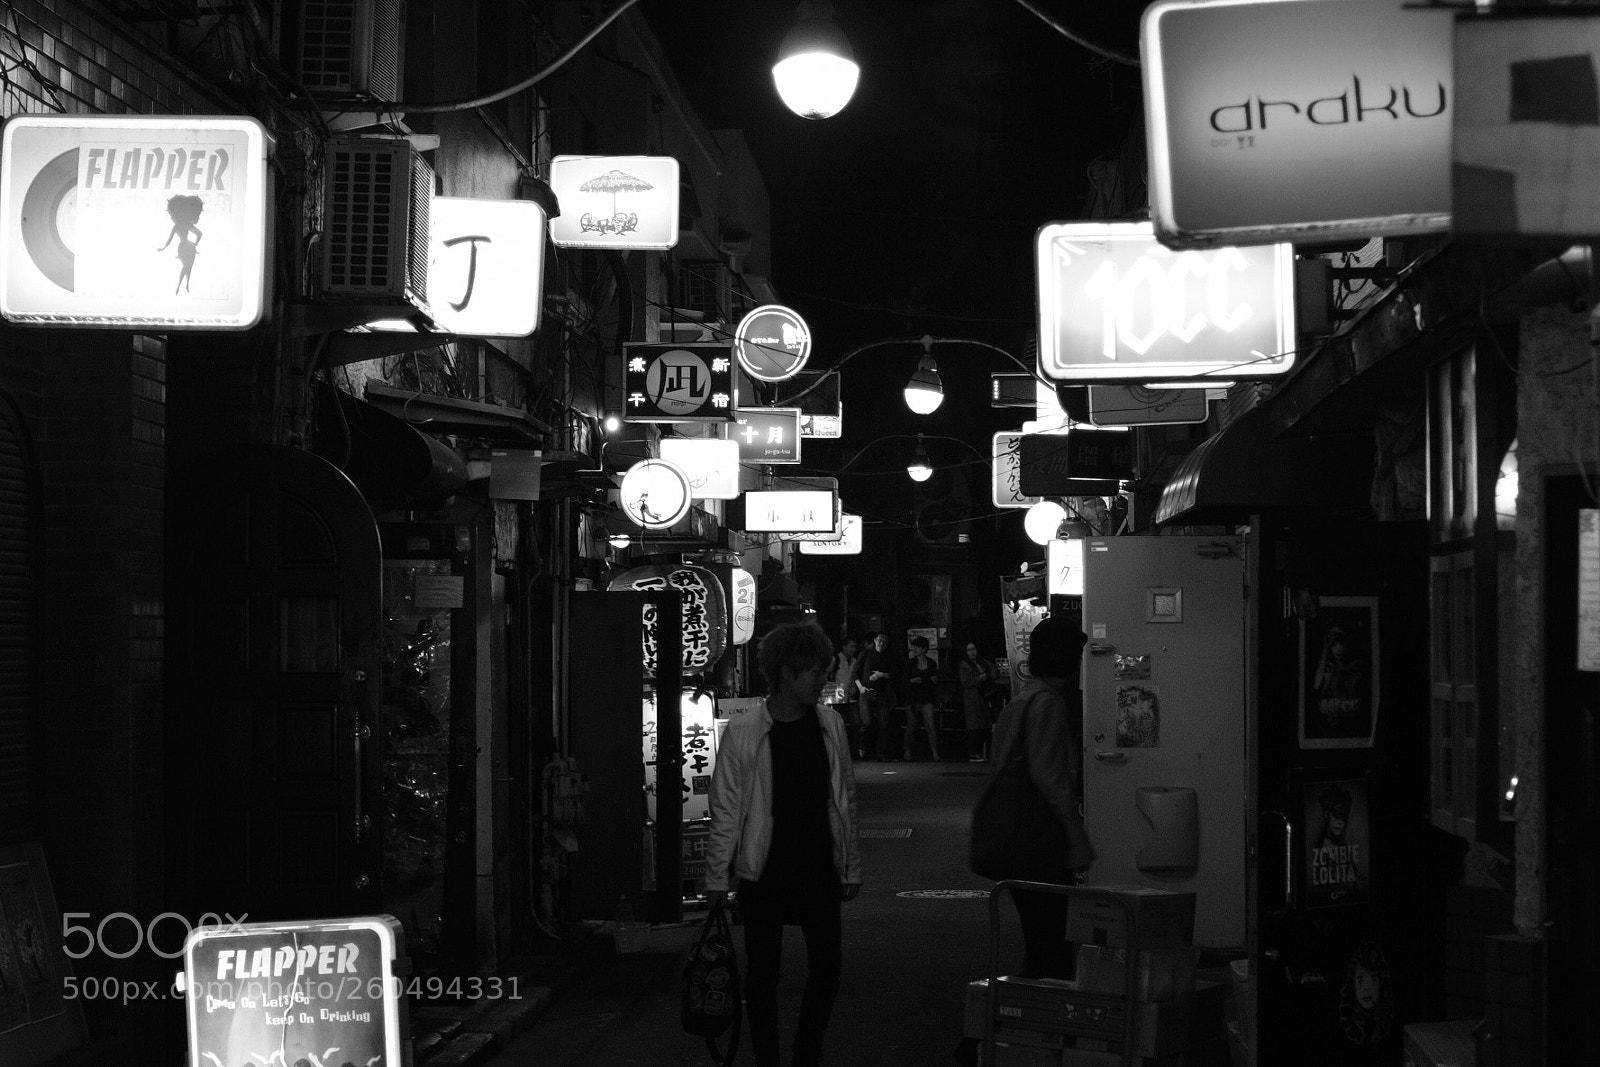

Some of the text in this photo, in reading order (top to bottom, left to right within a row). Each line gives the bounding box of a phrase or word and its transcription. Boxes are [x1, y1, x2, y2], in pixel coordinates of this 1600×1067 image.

[1210, 73, 1446, 133] araku
[85, 147, 229, 190] FLAPPER
[712, 358, 730, 408] 新宿
[741, 425, 784, 444] 十月
[1312, 844, 1360, 867] ZOMBIE
[1312, 864, 1357, 886] LOLITA
[217, 943, 360, 980] FLAPPER
[320, 1008, 371, 1023] Drinking
